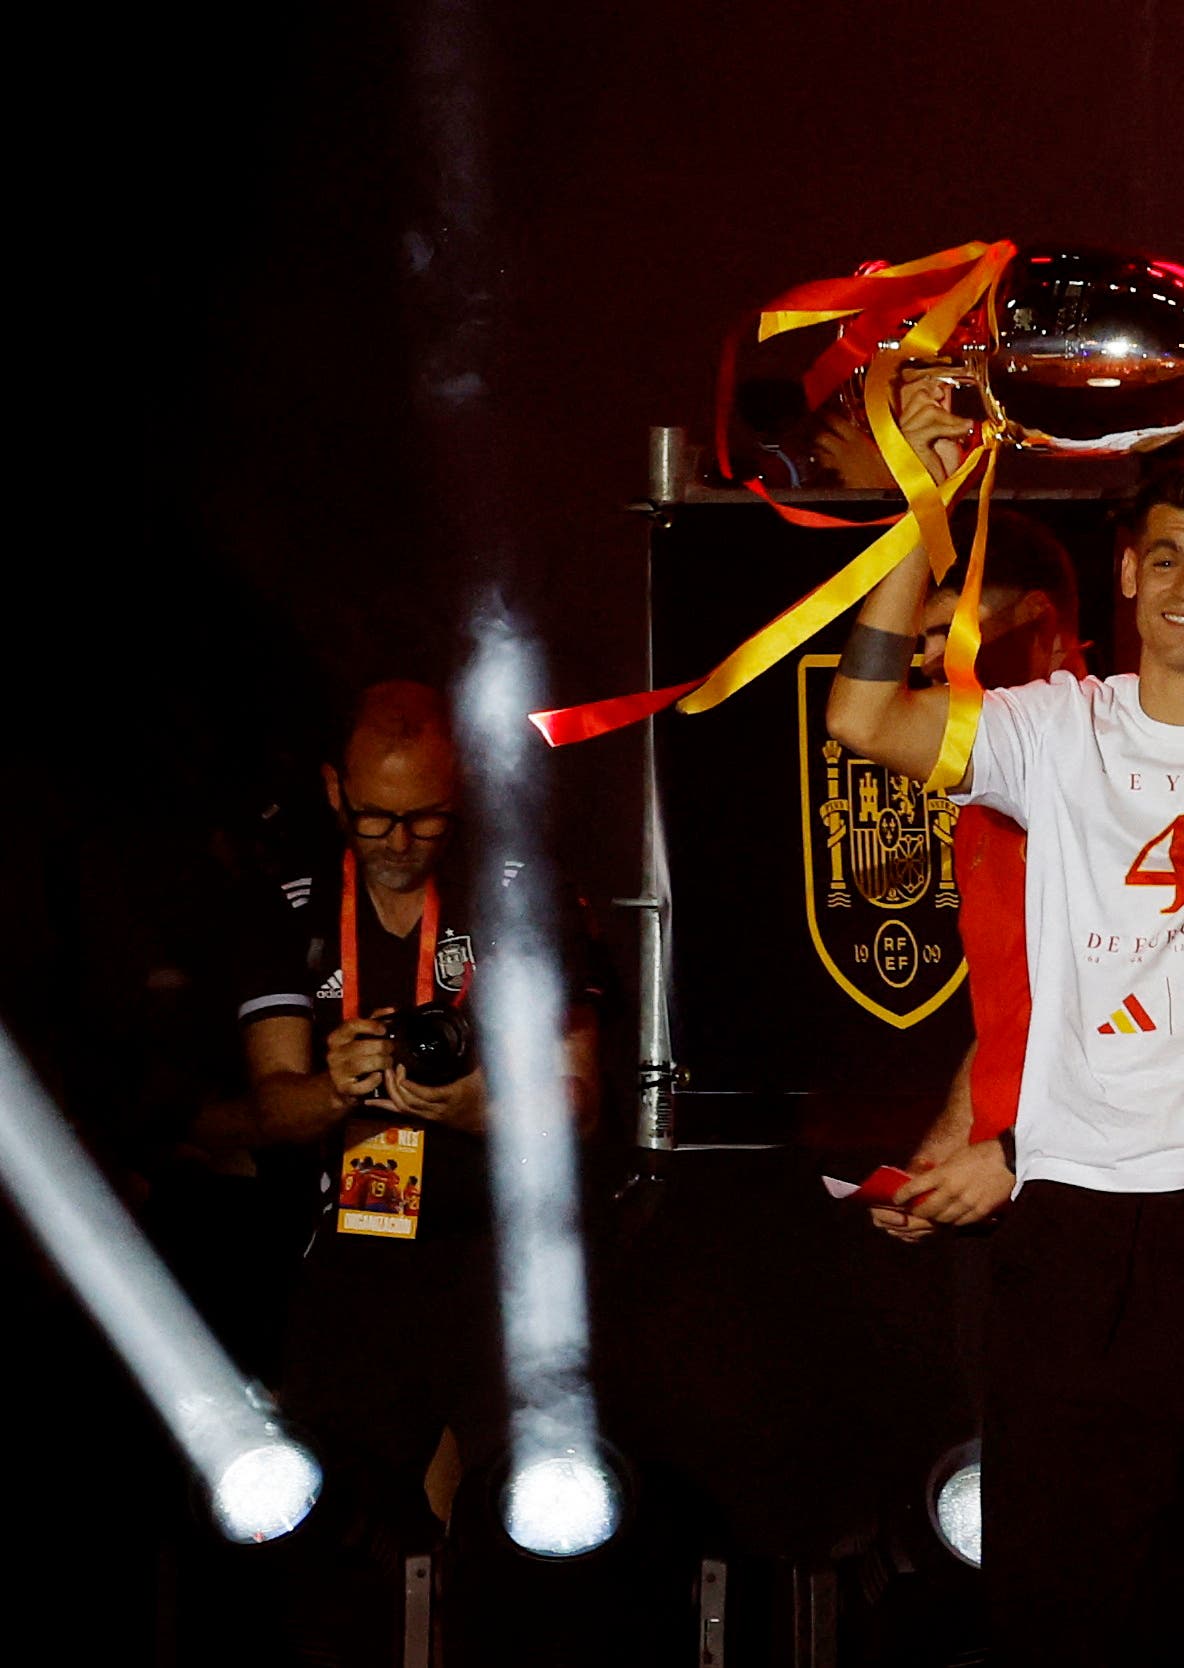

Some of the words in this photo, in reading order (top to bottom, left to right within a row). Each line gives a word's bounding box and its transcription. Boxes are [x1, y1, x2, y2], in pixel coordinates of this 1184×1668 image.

[883, 937, 907, 951] RF
[1087, 932, 1120, 953] DE
[854, 944, 869, 963] 19
[922, 944, 941, 963] 09
[884, 956, 908, 971] EF
[316, 988, 344, 999] adid
